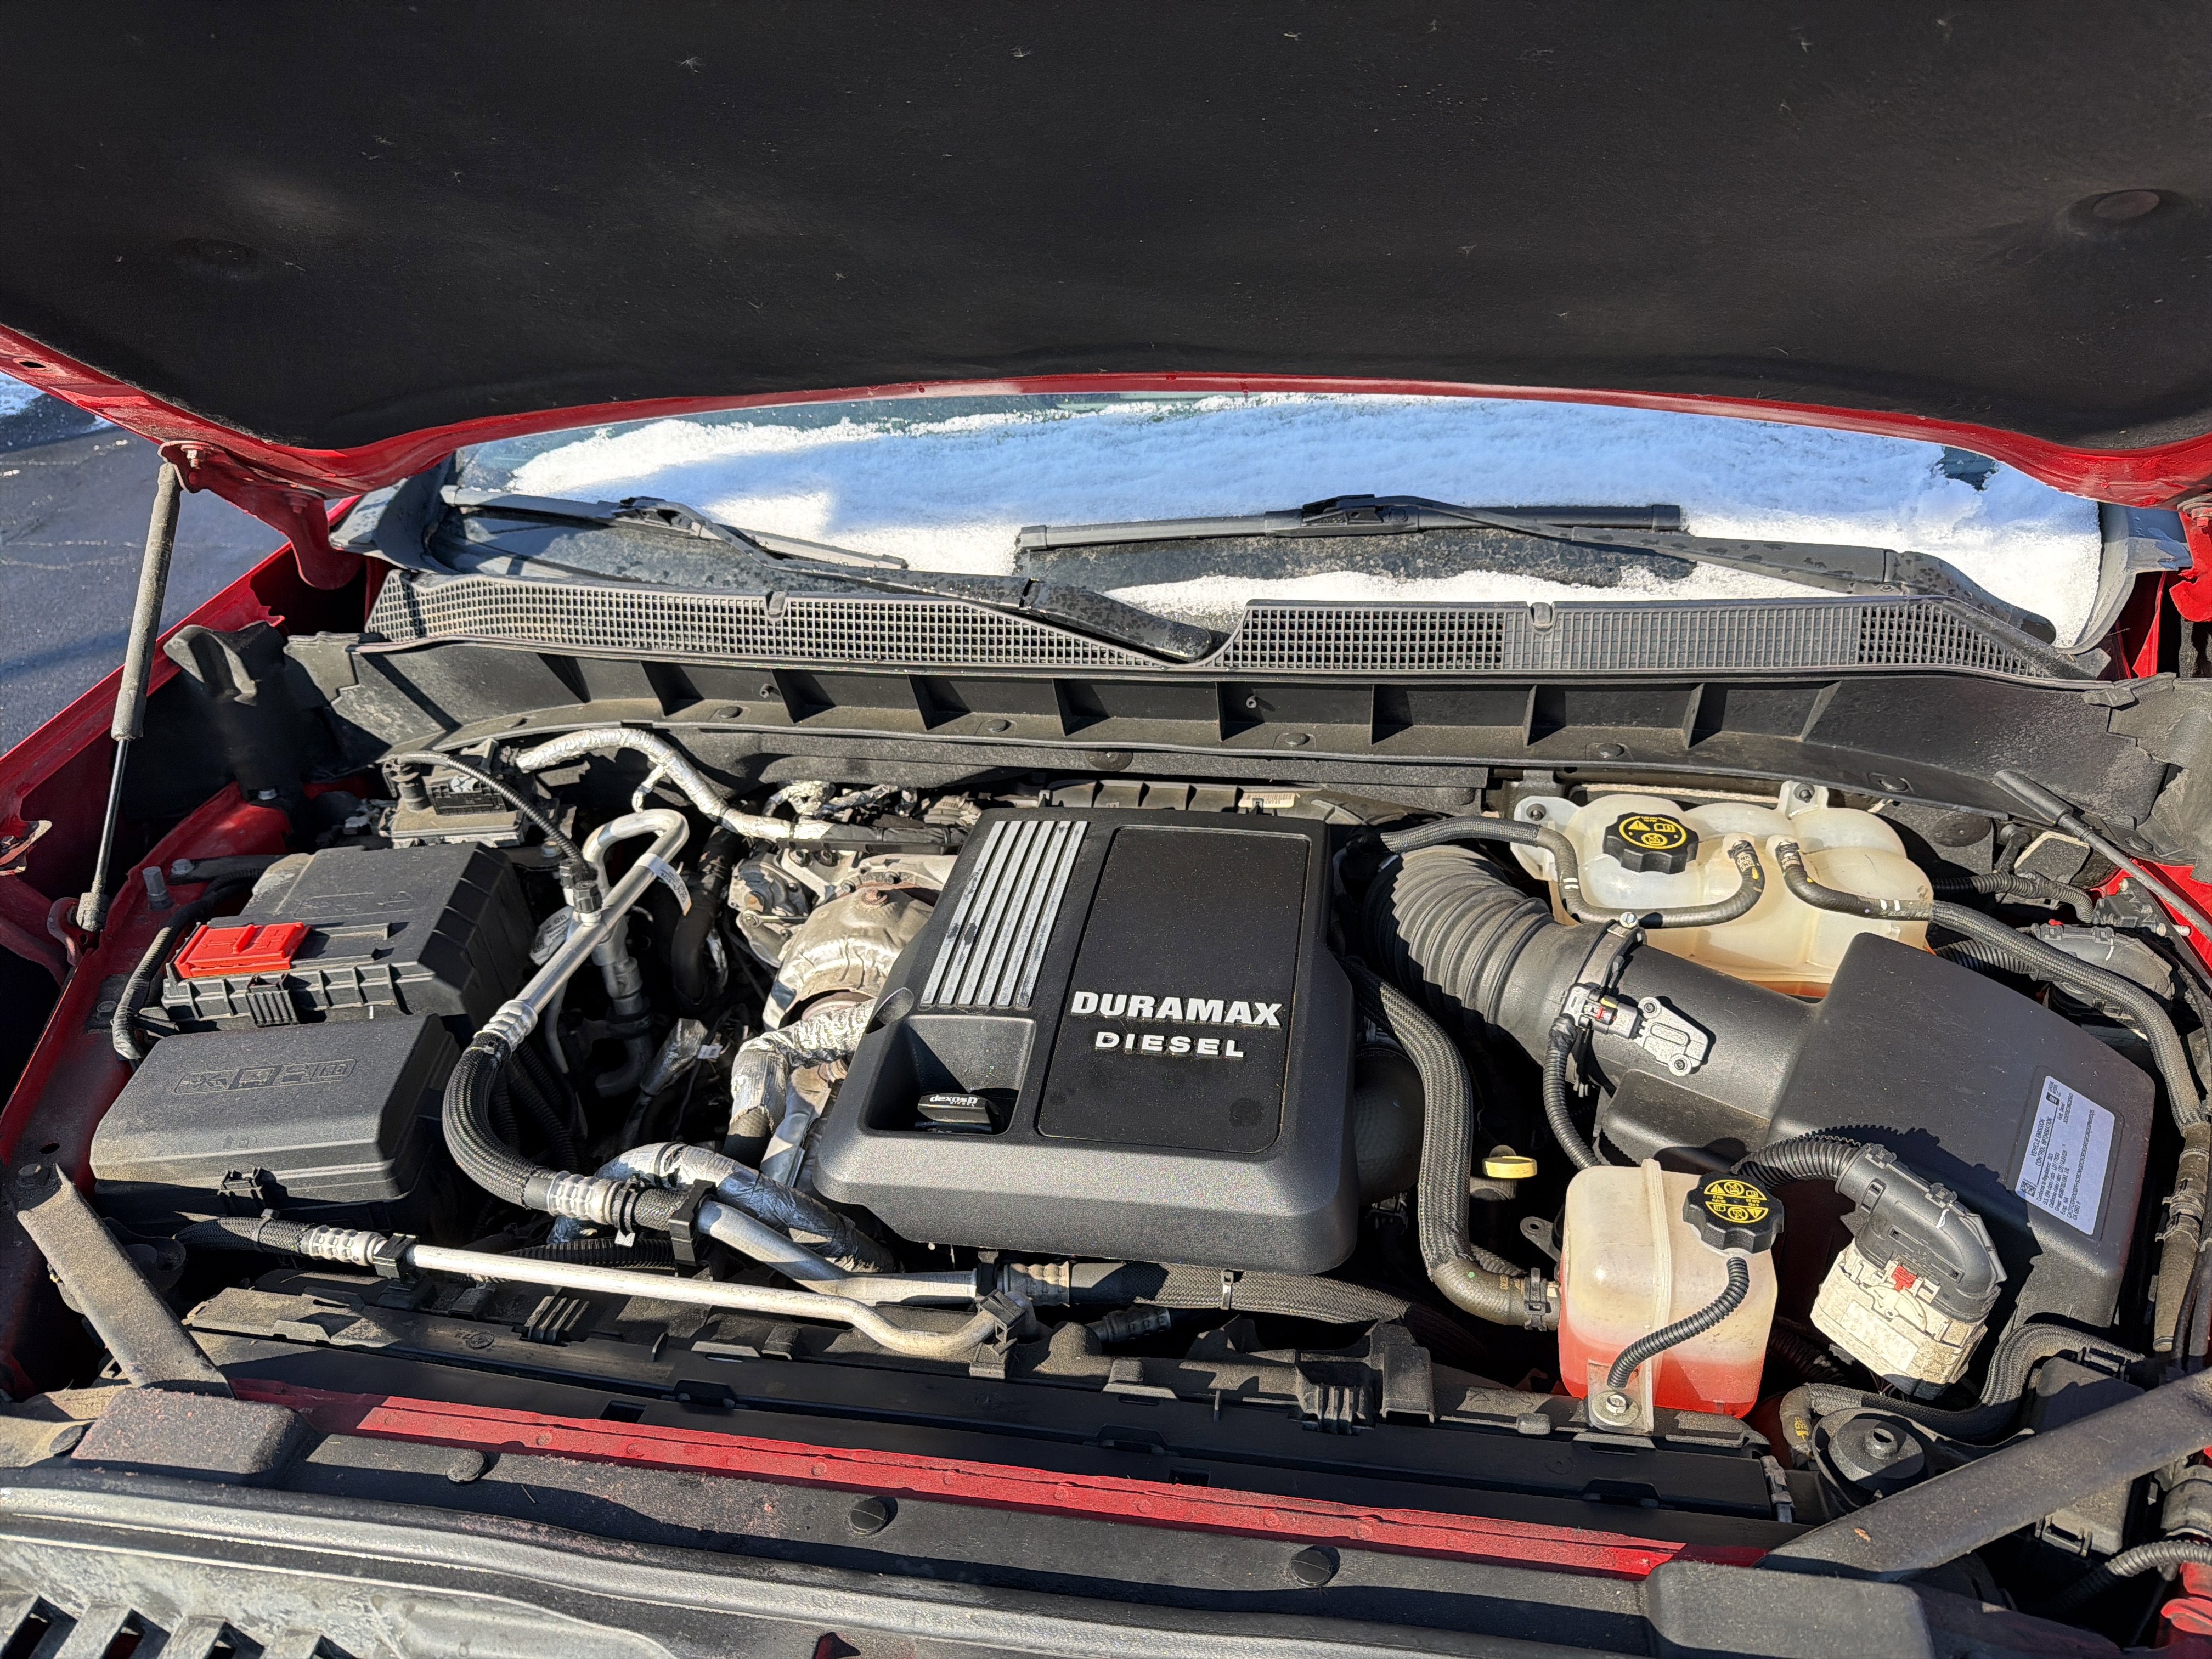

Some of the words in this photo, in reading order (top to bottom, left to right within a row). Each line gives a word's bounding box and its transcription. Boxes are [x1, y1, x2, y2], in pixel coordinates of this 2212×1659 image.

[1070, 991, 1282, 1027] DURAMAX
[1095, 1031, 1244, 1058] DIESEL
[2035, 1117, 2045, 1139] EMISSION
[2035, 1146, 2046, 1166] CONTROL
[2041, 1116, 2053, 1146] INFORMATION
[2030, 1137, 2041, 1156] VEHICLE
